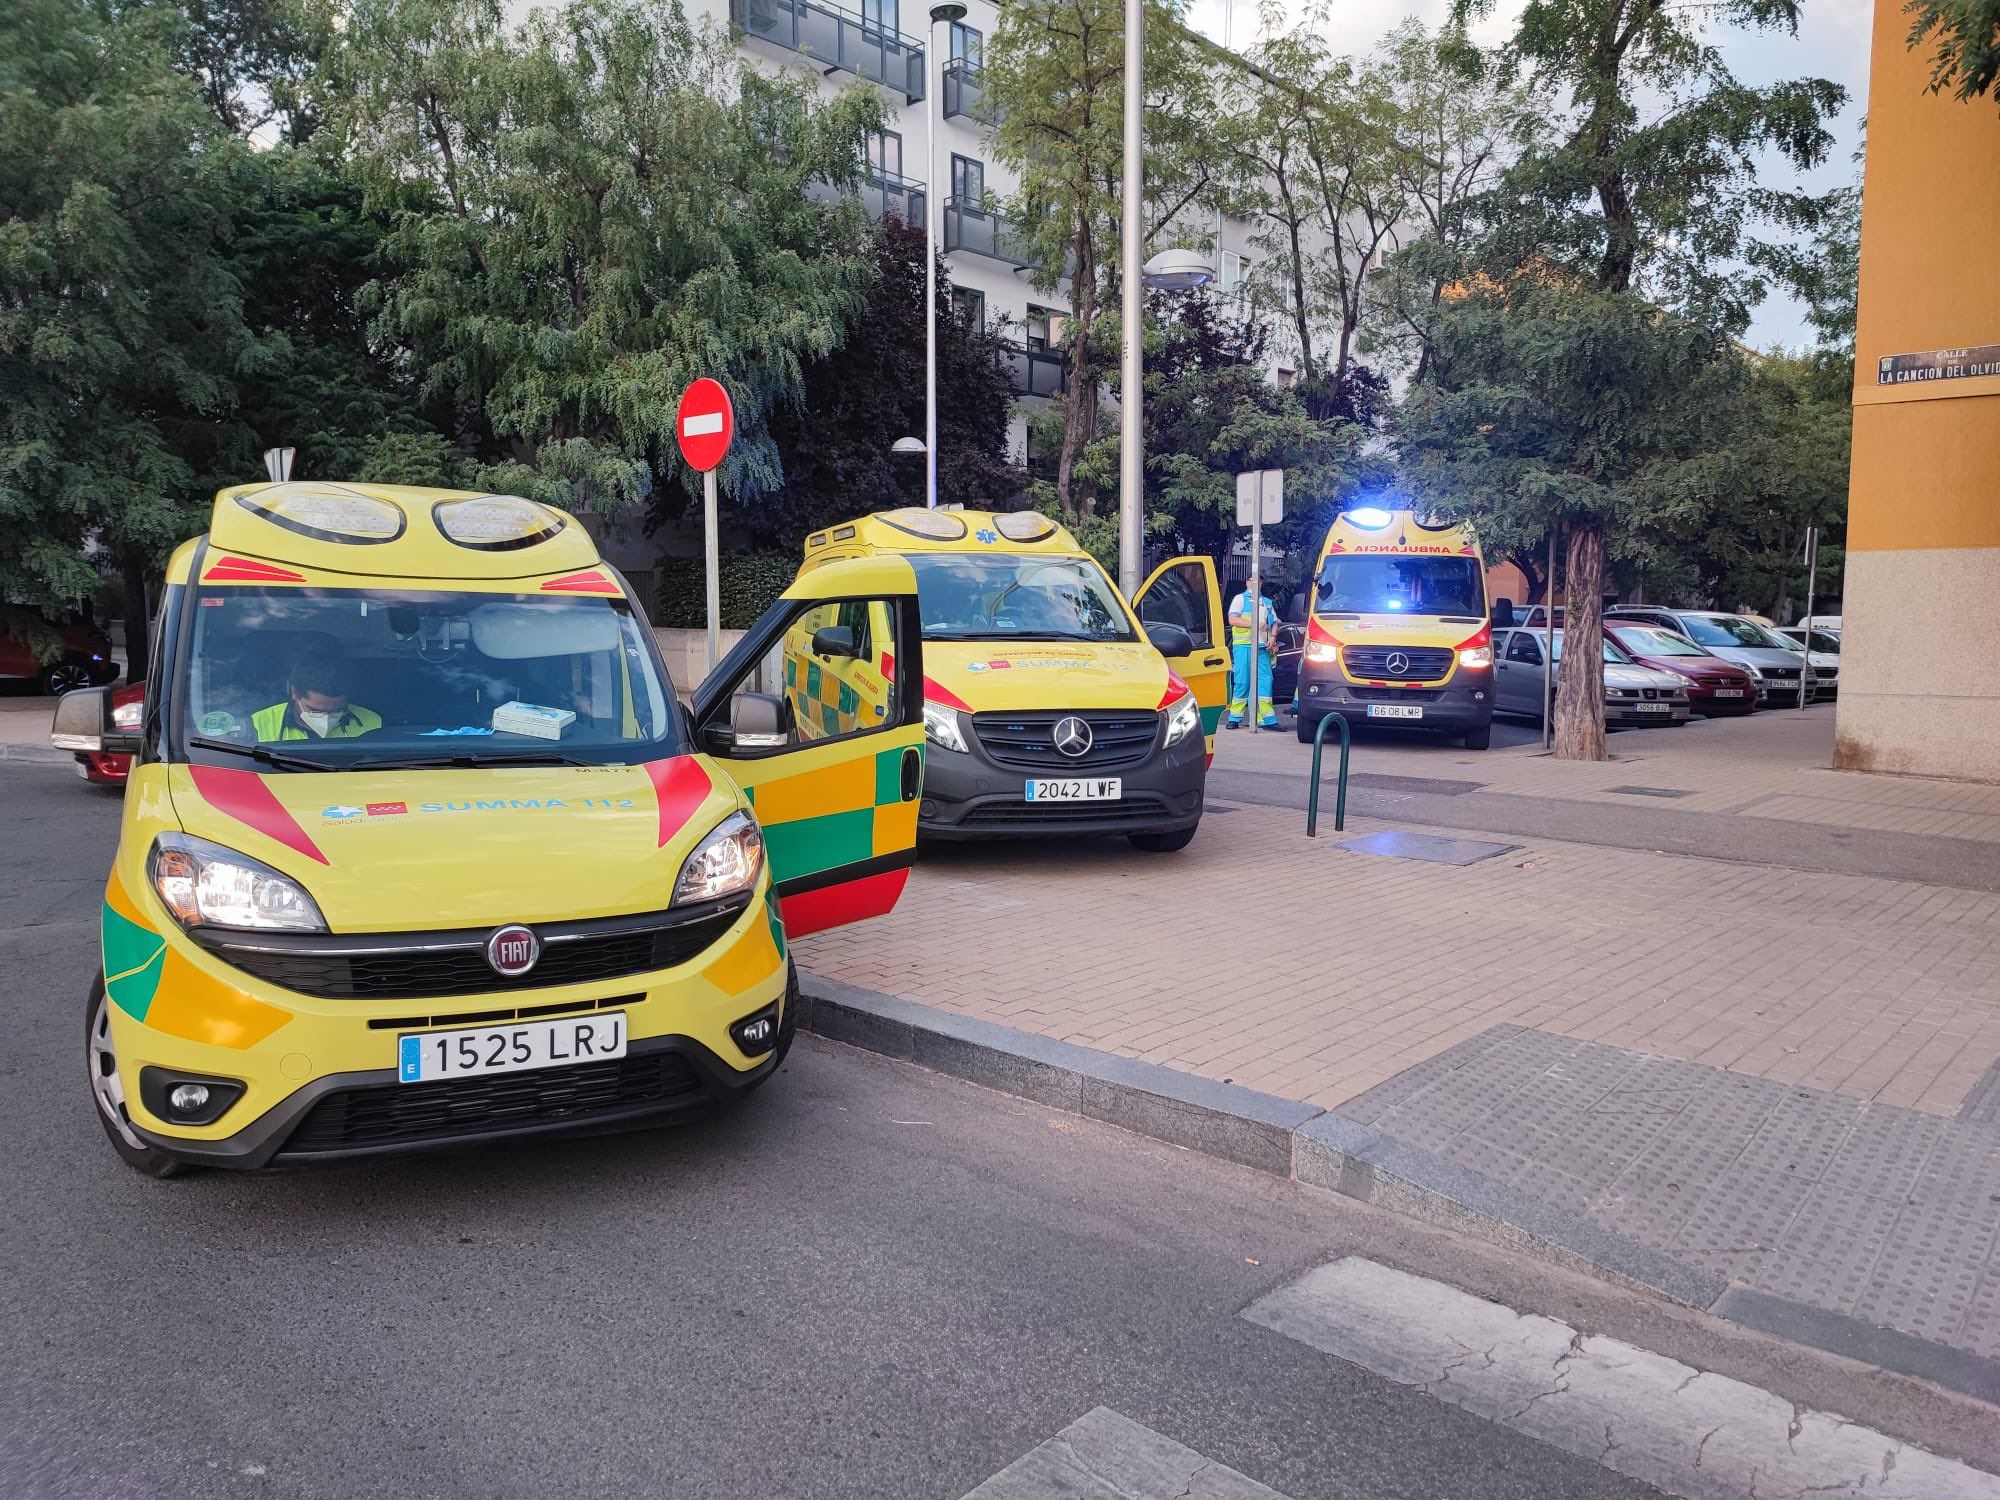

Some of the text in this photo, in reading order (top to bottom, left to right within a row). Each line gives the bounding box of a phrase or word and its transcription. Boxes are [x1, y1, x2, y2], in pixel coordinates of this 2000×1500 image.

[1936, 349, 1969, 359] CALLE
[1880, 372, 1893, 384] LA
[1897, 367, 1942, 382] CANCION
[1947, 365, 1966, 378] DEL
[1016, 660, 1094, 668] SUMMA
[1038, 782, 1081, 798] 2042
[1086, 781, 1117, 798] LWF
[420, 799, 636, 812] SUMMA 112
[500, 940, 529, 963] FIAT
[406, 1020, 620, 1074] E 1525 LRJ
